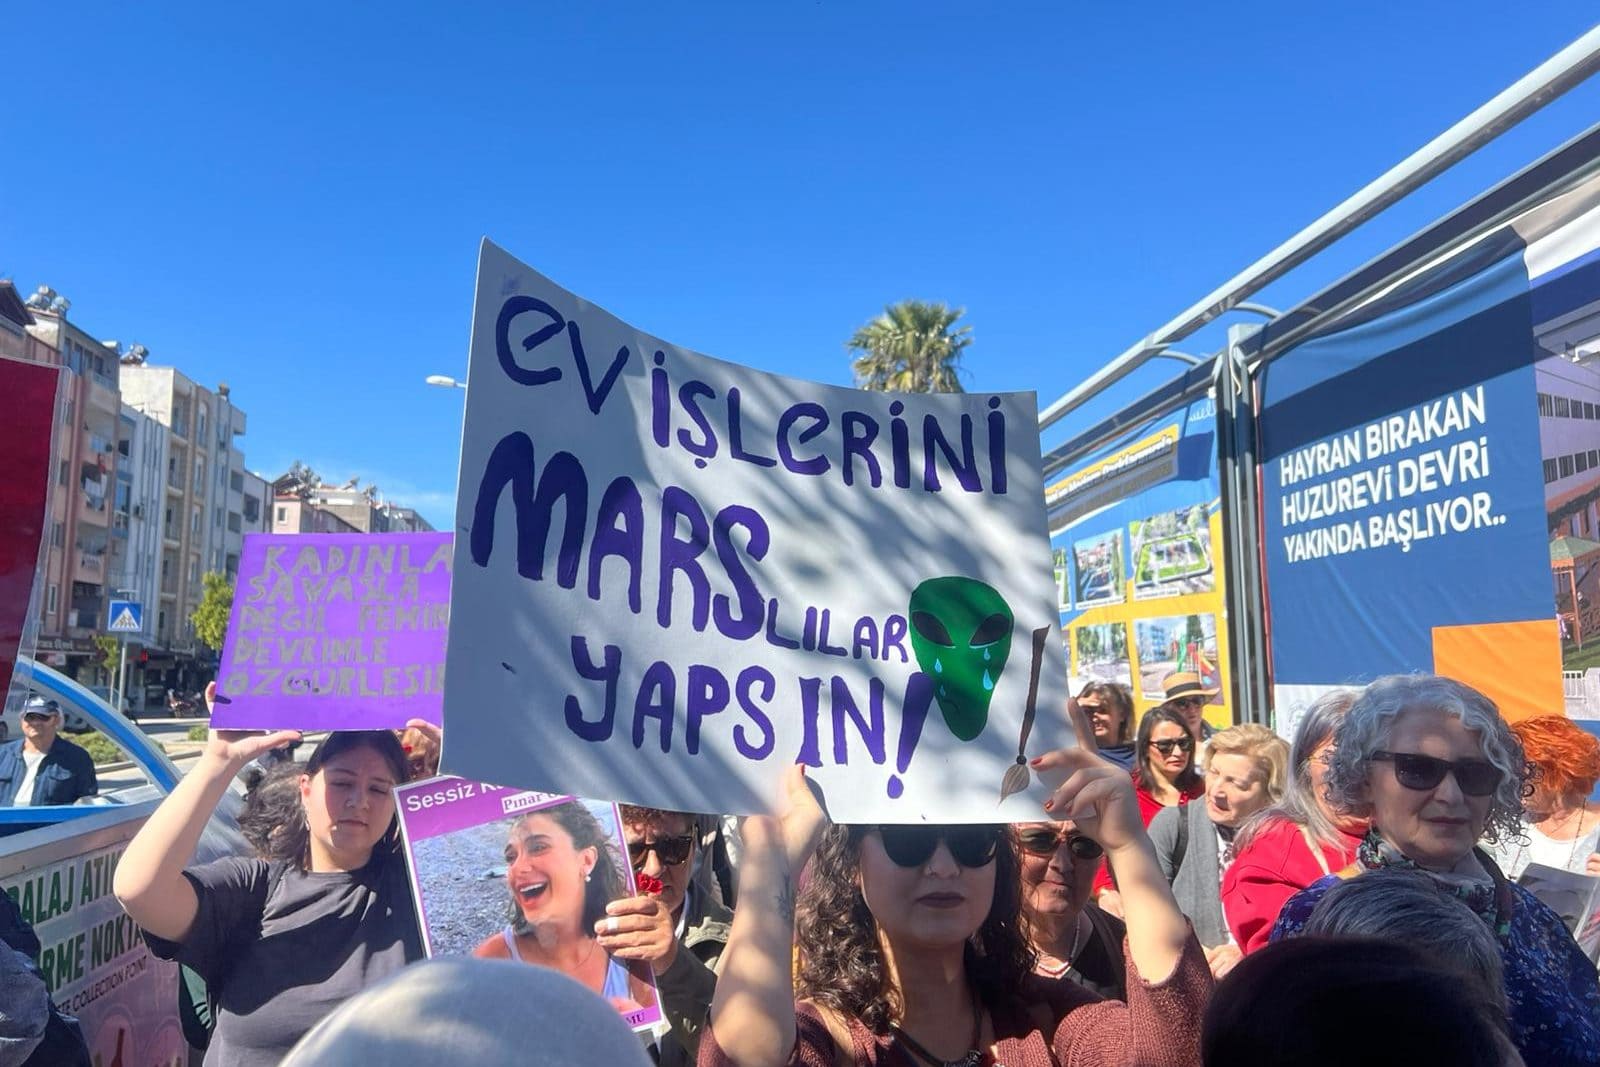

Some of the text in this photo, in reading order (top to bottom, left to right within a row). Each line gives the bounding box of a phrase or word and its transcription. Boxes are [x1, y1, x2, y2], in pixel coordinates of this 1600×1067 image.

[1280, 385, 1486, 487] HAYRAN BIRAKAN
[1283, 520, 1367, 564] YAKINDA
[406, 782, 476, 812] Sessiz
[504, 792, 543, 811] Pınar
[40, 932, 86, 994] RME
